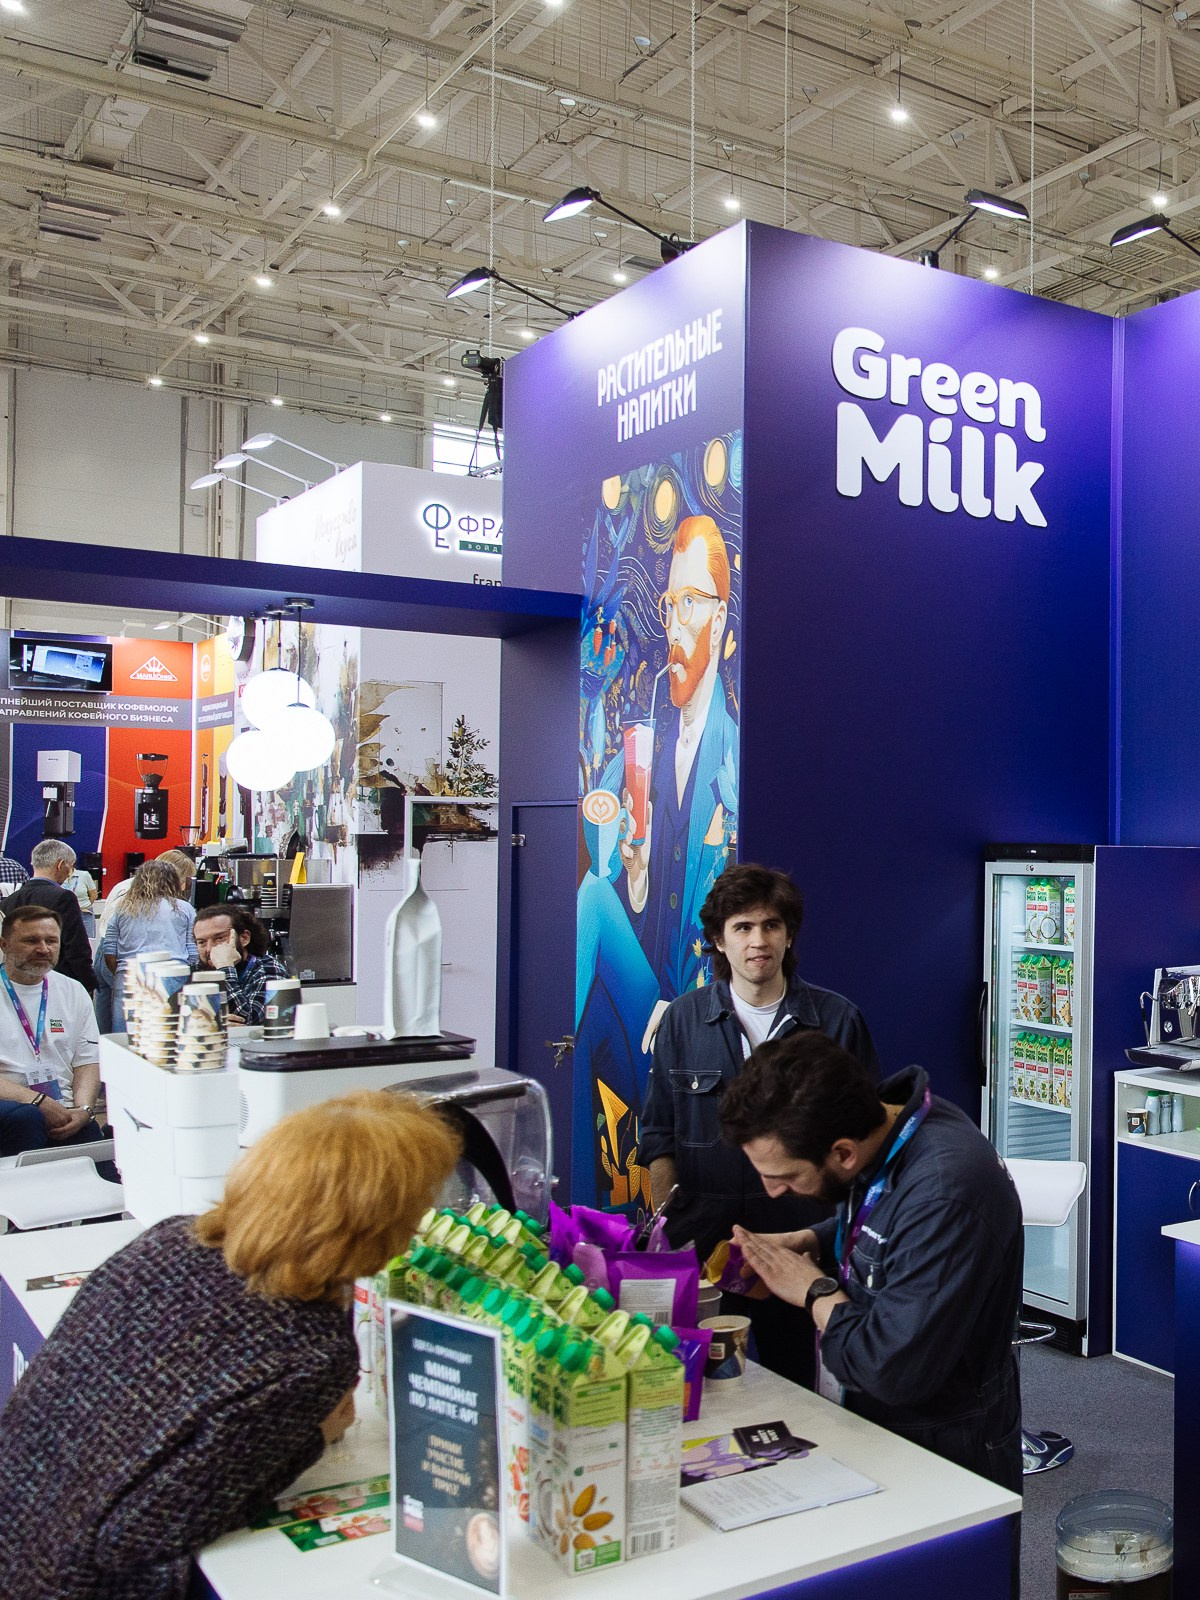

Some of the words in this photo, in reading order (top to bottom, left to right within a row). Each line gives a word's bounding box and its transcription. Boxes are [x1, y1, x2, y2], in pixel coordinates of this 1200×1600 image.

[597, 308, 723, 407] РАСТИТЕЛЬНЫЕ
[832, 326, 1047, 442] Green
[617, 370, 697, 443] НАПИТКИ
[836, 401, 1048, 528] Milk
[54, 700, 117, 711] ПОСТАВЩИК
[118, 703, 179, 713] КОФЕМОЛОК
[68, 711, 128, 722] КОФЕЙНОГО
[130, 714, 173, 723] БИЗНЕСА
